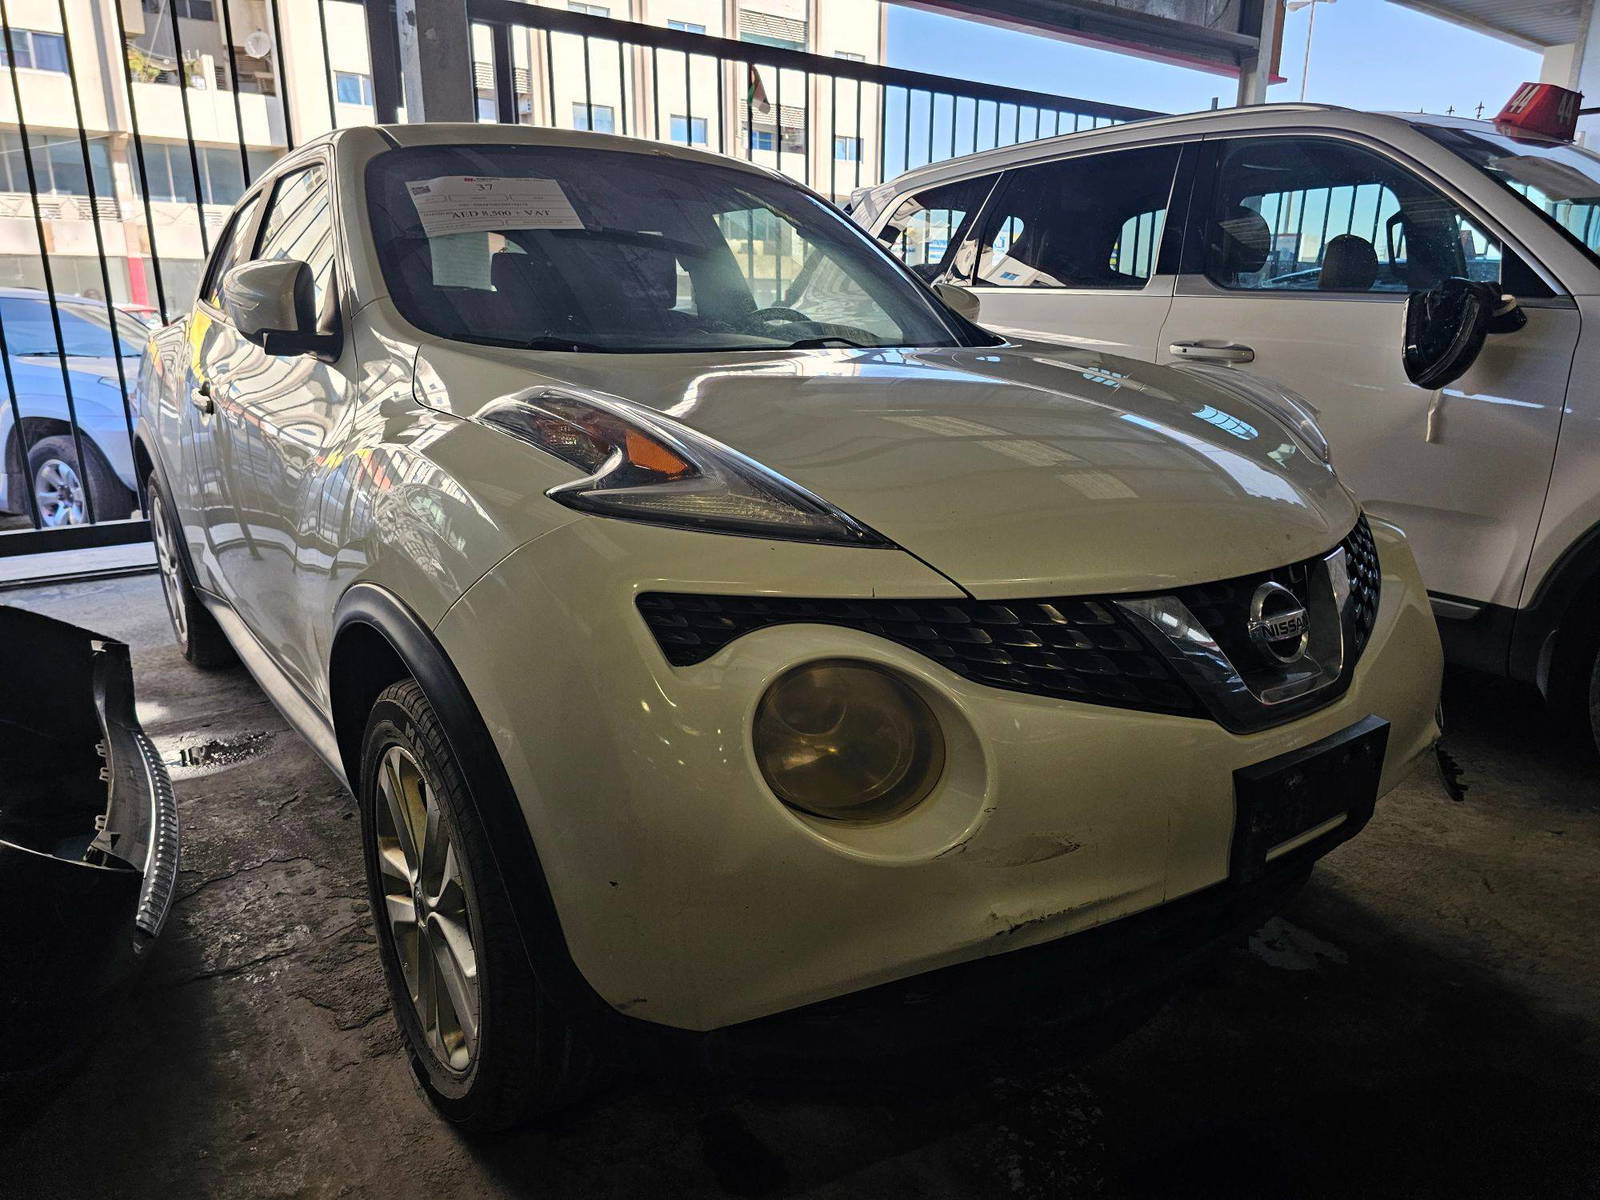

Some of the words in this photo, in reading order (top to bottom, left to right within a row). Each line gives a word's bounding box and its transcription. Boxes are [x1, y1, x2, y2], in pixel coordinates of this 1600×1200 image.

[1509, 84, 1540, 113] 44
[1557, 91, 1576, 125] 44
[478, 183, 493, 192] 37
[452, 209, 479, 218] AED
[523, 208, 551, 216] VAT
[1262, 614, 1310, 638] NISSAN
